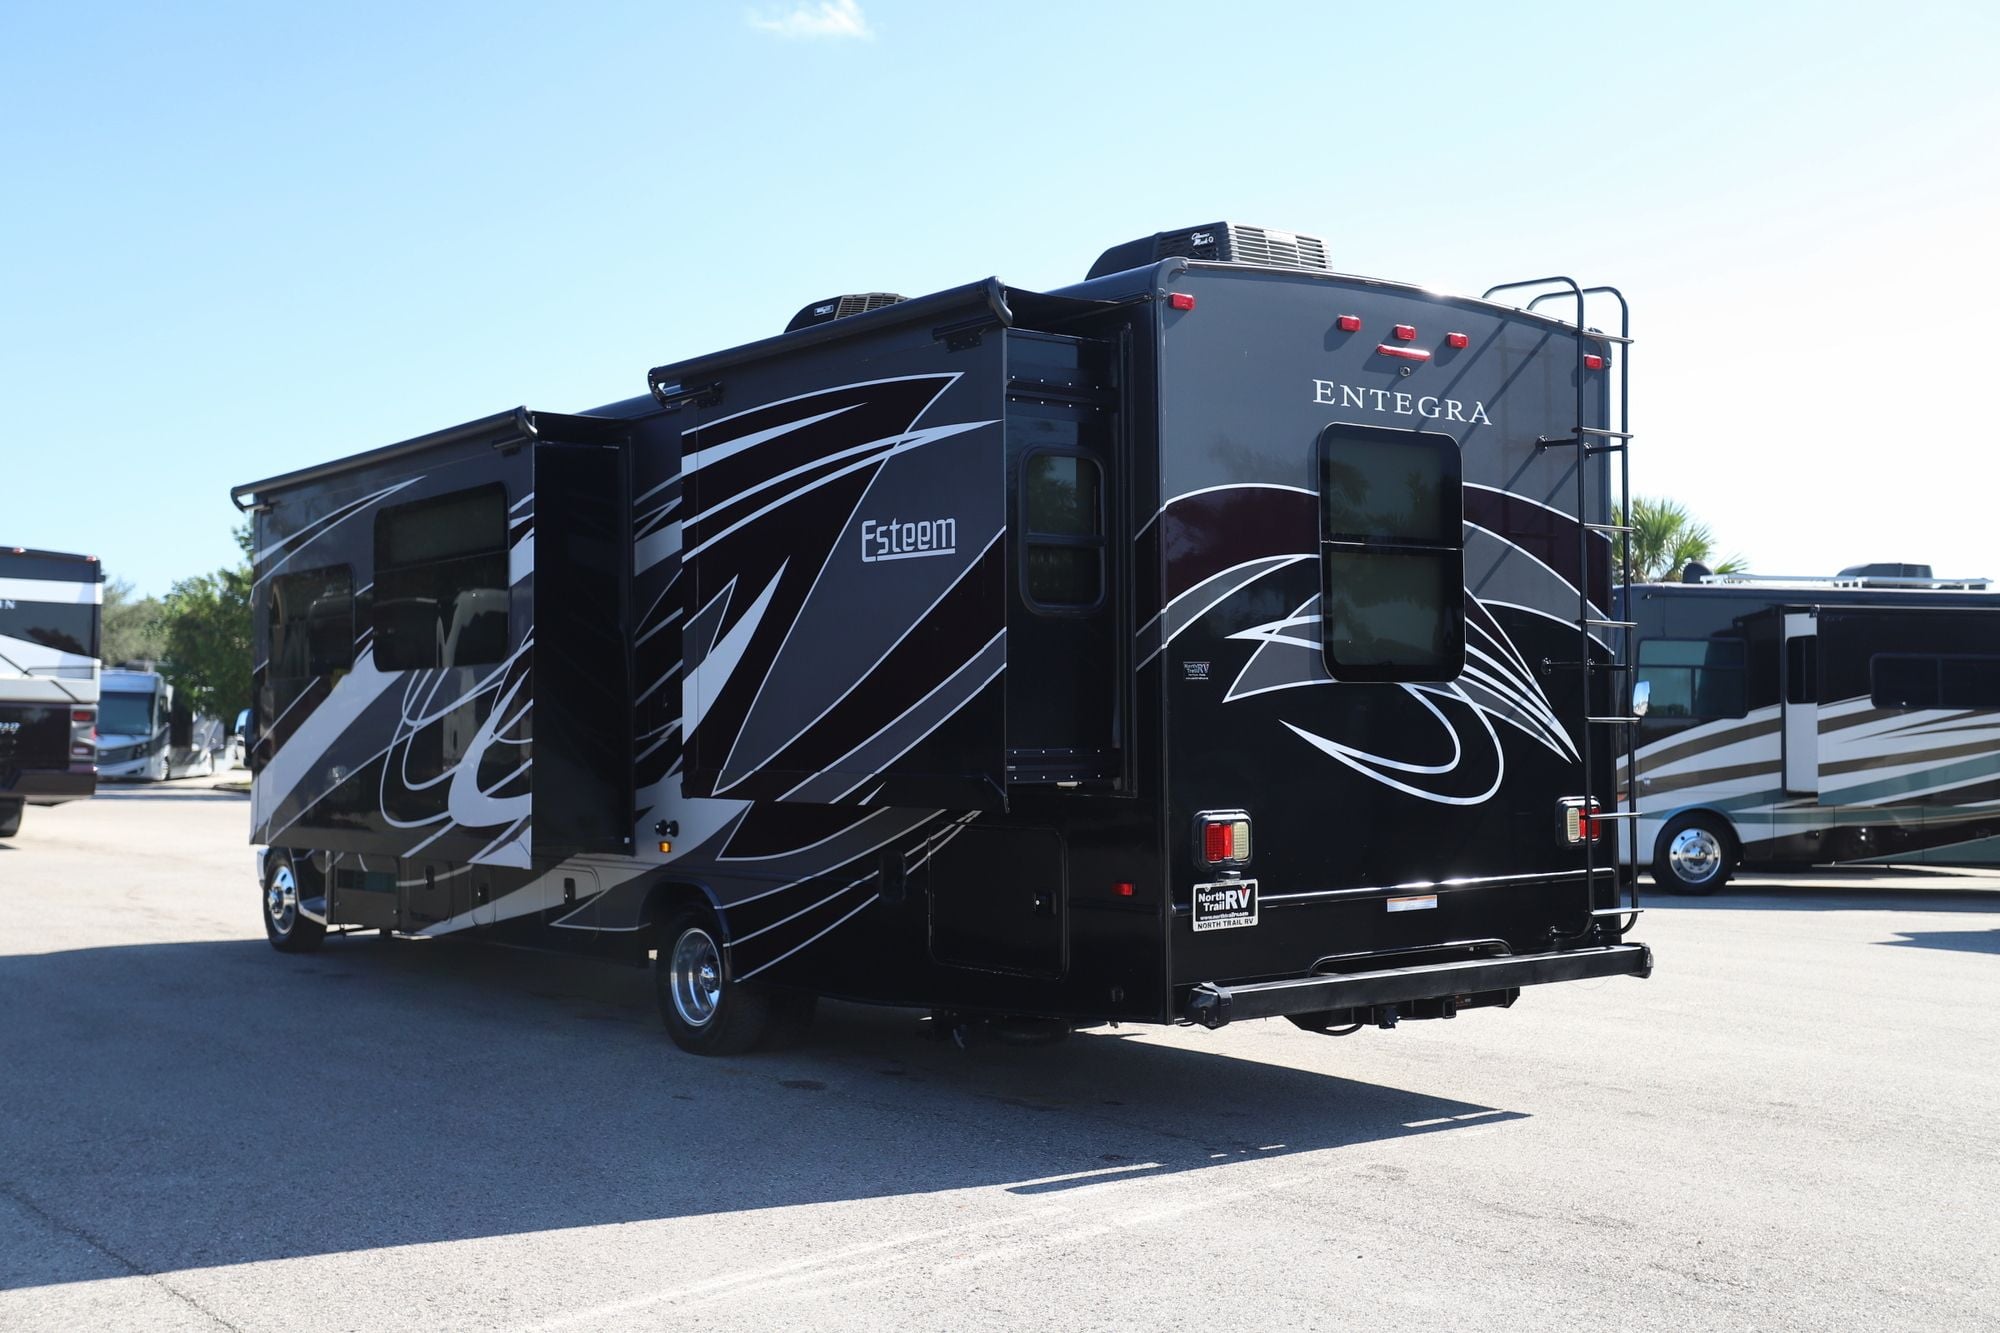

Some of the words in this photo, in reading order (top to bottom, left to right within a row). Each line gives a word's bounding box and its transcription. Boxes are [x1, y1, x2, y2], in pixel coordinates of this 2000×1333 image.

[1312, 378, 1492, 426] ENTEGRA
[861, 517, 956, 563] Esteem
[1198, 891, 1225, 903] North
[1225, 888, 1251, 910] RV
[1203, 901, 1225, 912] Trail
[1197, 921, 1221, 930] NORTH
[1223, 919, 1242, 927] TRAIL
[1244, 917, 1254, 925] RV
